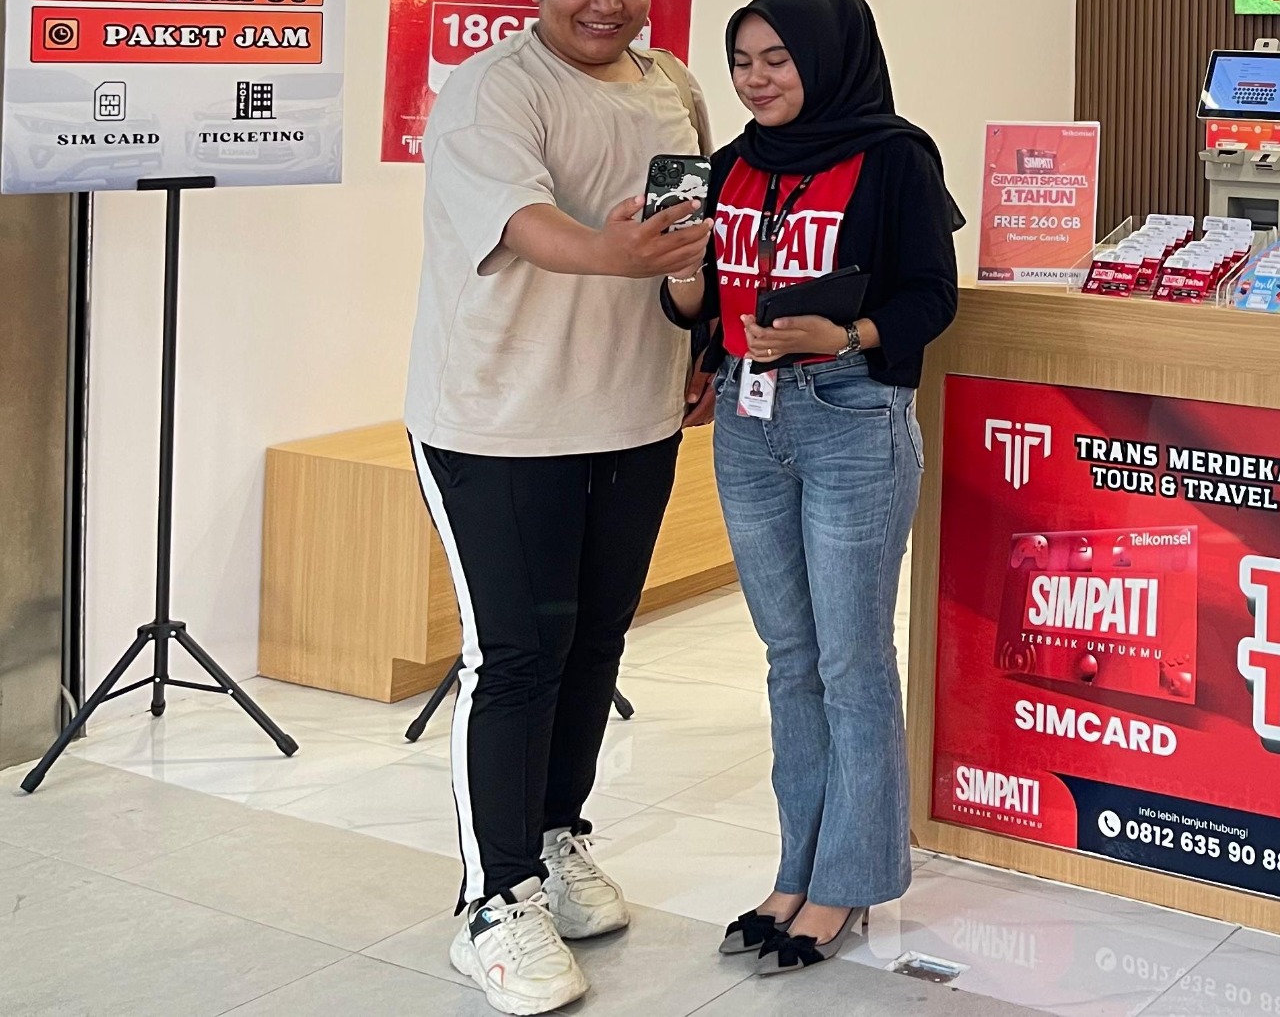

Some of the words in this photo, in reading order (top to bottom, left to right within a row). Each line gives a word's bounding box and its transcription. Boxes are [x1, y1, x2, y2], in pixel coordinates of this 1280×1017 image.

[104, 25, 226, 48] PAKET
[235, 25, 311, 49] JAM
[239, 82, 248, 117] HOTEL
[57, 134, 97, 146] SIM
[103, 132, 160, 145] CARD
[199, 131, 305, 143] TICKETING
[1024, 157, 1054, 169] SIMPATI
[993, 174, 1039, 186] SIMPATI
[1040, 175, 1086, 186] SPECIAL
[1004, 190, 1013, 203] 1
[1016, 190, 1074, 204] TAHUN
[994, 215, 1026, 228] FREE
[1030, 215, 1058, 228] 260
[1061, 216, 1081, 229] GB
[714, 210, 838, 273] SIMPAT
[720, 275, 760, 289] BAIK
[1020, 271, 1058, 279] DAPATKAN
[1076, 436, 1158, 466] TRANS
[1093, 466, 1154, 493] TOUR
[1161, 476, 1176, 496] &
[1184, 478, 1278, 509] TRAVEL
[1130, 531, 1191, 546] Telkomsel
[1028, 575, 1158, 637] SIMPATI
[1021, 632, 1078, 649] TERBAIK
[1087, 641, 1162, 660] UNTUKMU
[1015, 699, 1177, 757] SIMCARD
[955, 765, 1040, 816] SIMPATI
[952, 804, 991, 819] TERBAIK
[996, 813, 1043, 829] UNTUKMU
[1138, 806, 1157, 819] Info
[1157, 809, 1180, 824] lebih
[1181, 815, 1208, 830] lanjut
[1209, 820, 1249, 839] hubungi
[1126, 820, 1174, 848] 0812
[1180, 831, 1221, 858] 635
[1228, 841, 1256, 865] 90
